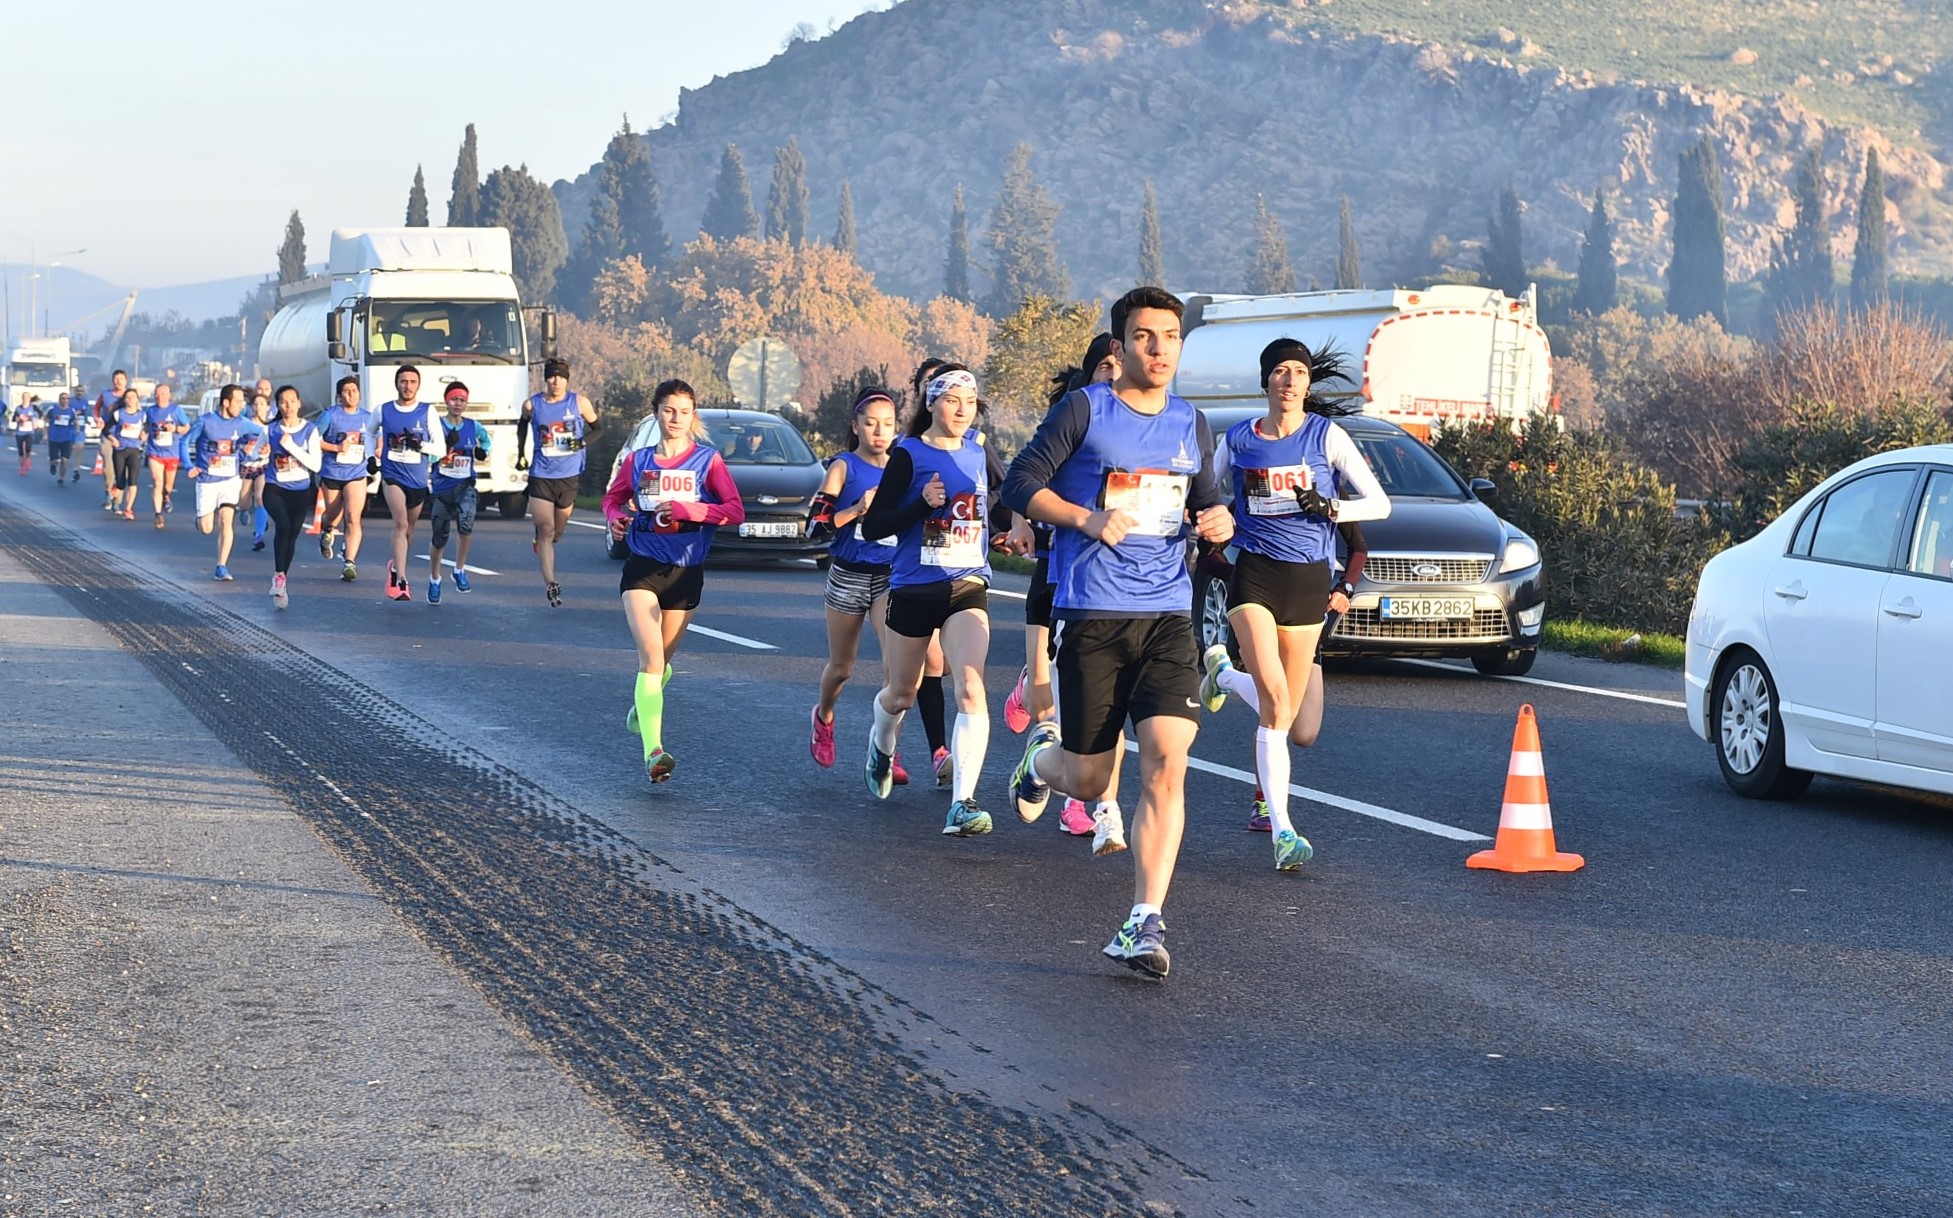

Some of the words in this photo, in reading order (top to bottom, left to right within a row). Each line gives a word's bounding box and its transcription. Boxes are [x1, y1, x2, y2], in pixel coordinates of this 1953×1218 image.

[662, 475, 693, 492] 006
[1272, 470, 1307, 491] 061
[953, 525, 981, 544] 067
